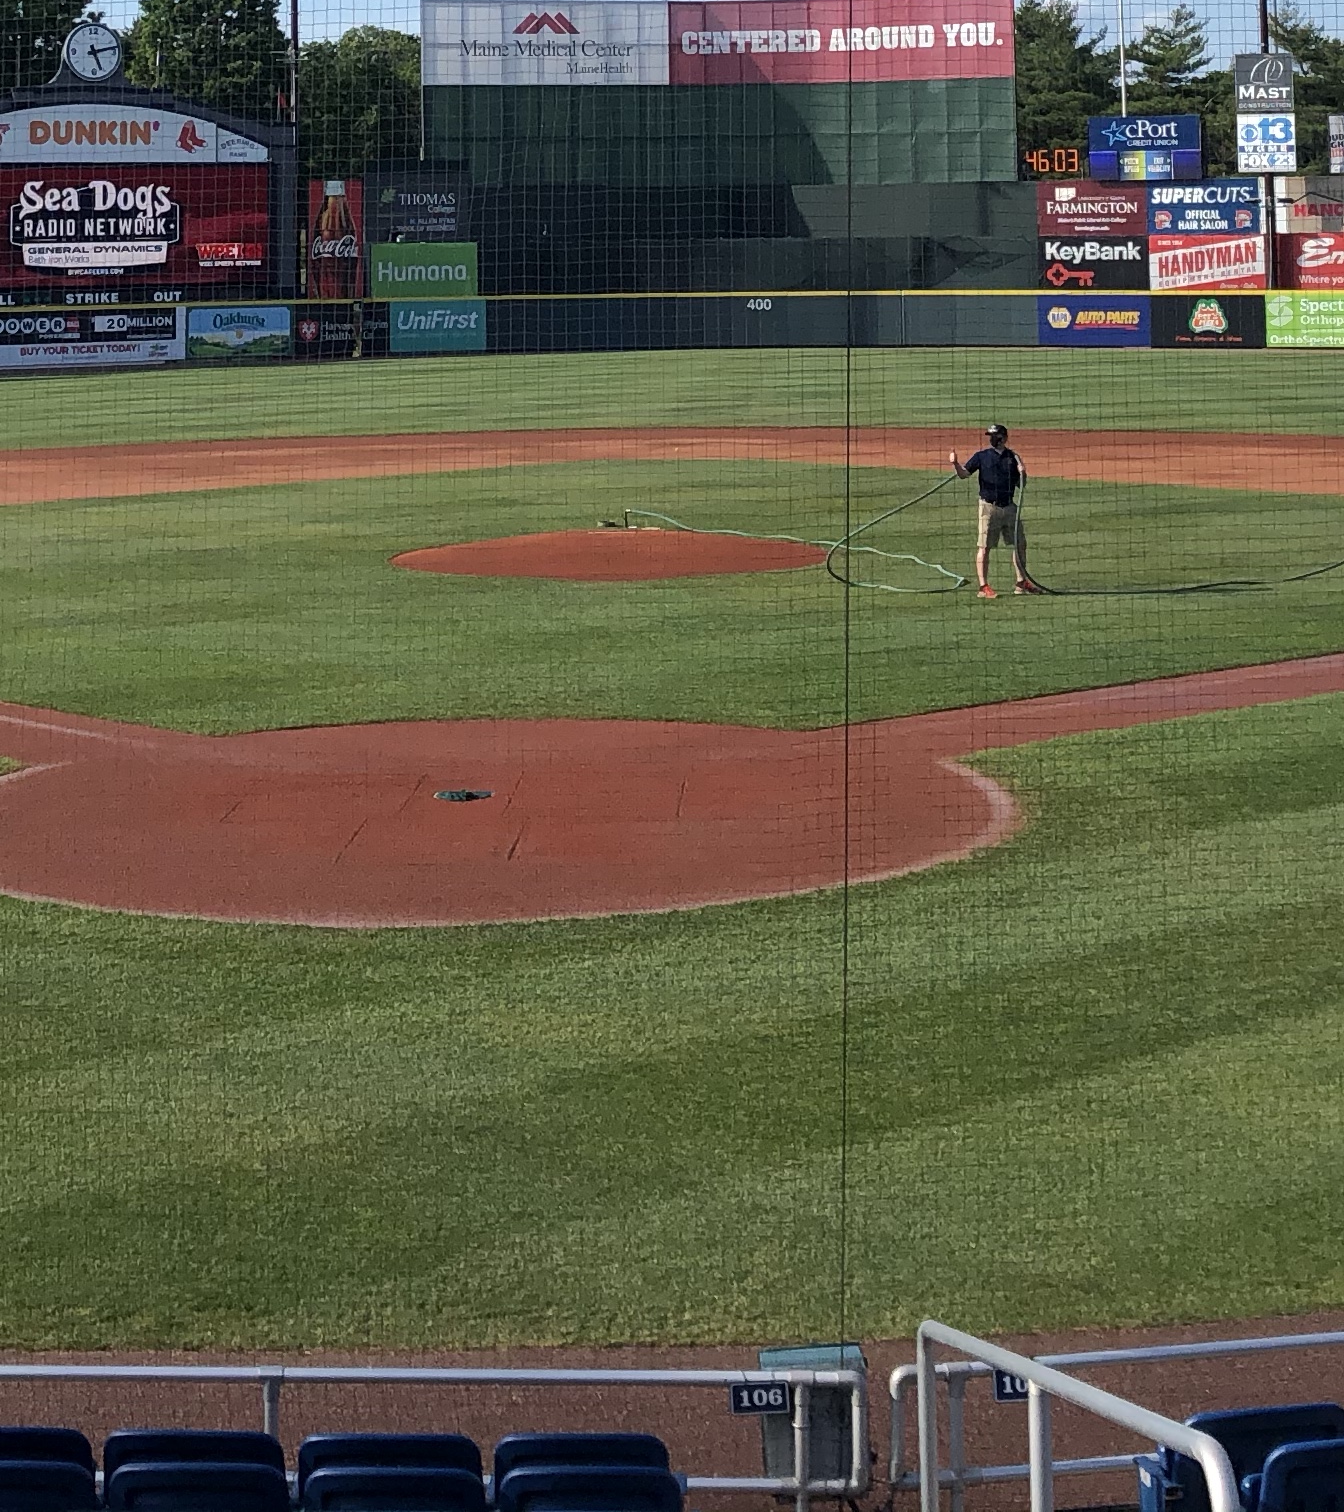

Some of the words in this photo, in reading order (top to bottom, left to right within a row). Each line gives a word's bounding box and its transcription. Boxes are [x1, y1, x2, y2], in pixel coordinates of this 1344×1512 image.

[682, 29, 821, 54] CENTERED
[829, 24, 934, 51] AROUND
[943, 22, 1003, 47] YOU.
[458, 40, 509, 57] Maine
[513, 40, 576, 57] Medical
[581, 40, 633, 57] Center
[566, 62, 633, 74] MaineHealth
[1239, 85, 1290, 99] MAST
[29, 120, 160, 145] DUNKIN'
[1126, 120, 1178, 138] cPort
[1259, 118, 1292, 143] 13
[1025, 149, 1080, 172] 46:03
[1240, 154, 1268, 168] FOX
[19, 181, 80, 220] Sea
[87, 182, 171, 221] Dogs
[398, 193, 455, 205] THOMAS
[1151, 187, 1251, 204] SUPERCUTS
[1046, 202, 1138, 215] FARMINGTON
[1185, 210, 1220, 219] OFFICIAL
[24, 219, 77, 237] RADIO
[84, 218, 167, 236] NETWORK
[1178, 220, 1199, 229] HAIR
[1200, 220, 1228, 230] SALON
[28, 247, 90, 255] GENERAL
[94, 245, 163, 254] DYNAMICS
[1044, 241, 1141, 264] KeyBank
[1158, 241, 1257, 278] HANDYMAN
[378, 261, 467, 282] Humana
[1299, 274, 1330, 284] Where
[65, 292, 119, 304] STRIKE
[153, 291, 182, 302] OUT
[747, 299, 772, 311] 400
[106, 318, 126, 329] 20
[127, 316, 173, 327] MILLION
[213, 313, 265, 330] Oakhurst
[397, 310, 479, 330] UniFirst
[1075, 311, 1105, 324] AUTO
[1106, 311, 1141, 324] PARTS
[20, 347, 40, 357] BUY
[42, 347, 68, 356] YOUR
[72, 345, 104, 355] TICKET
[106, 344, 141, 354] TODAY!
[739, 1389, 783, 1407] 106
